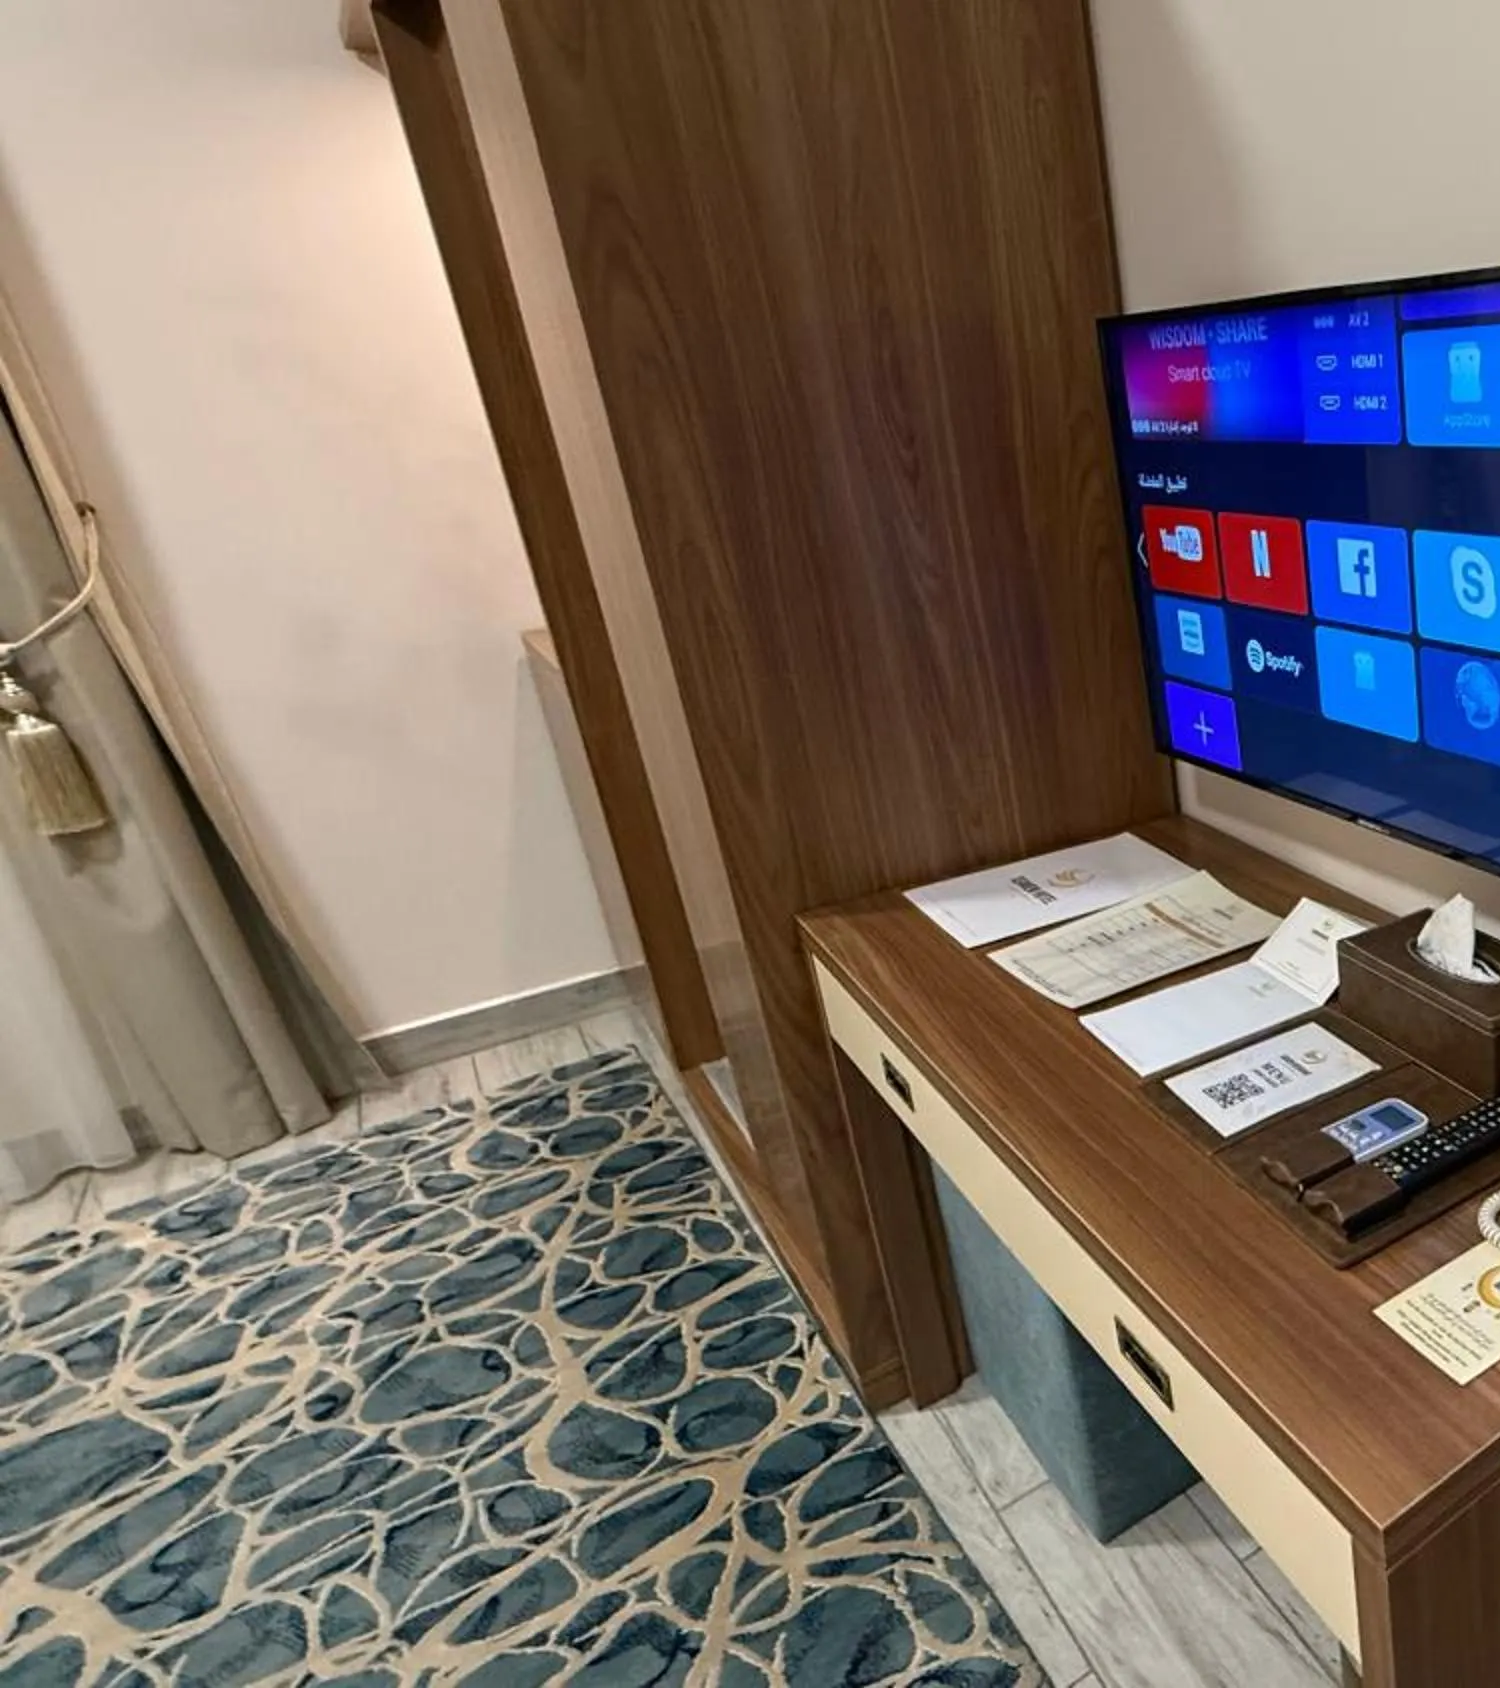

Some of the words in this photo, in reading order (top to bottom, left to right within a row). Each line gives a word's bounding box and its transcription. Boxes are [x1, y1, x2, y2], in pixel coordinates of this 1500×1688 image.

[1150, 322, 1206, 350] WISDOM
[1215, 315, 1268, 344] SHARE
[1159, 525, 1203, 562] YouTube
[1461, 561, 1485, 604] S
[1265, 650, 1303, 679] Spotify
